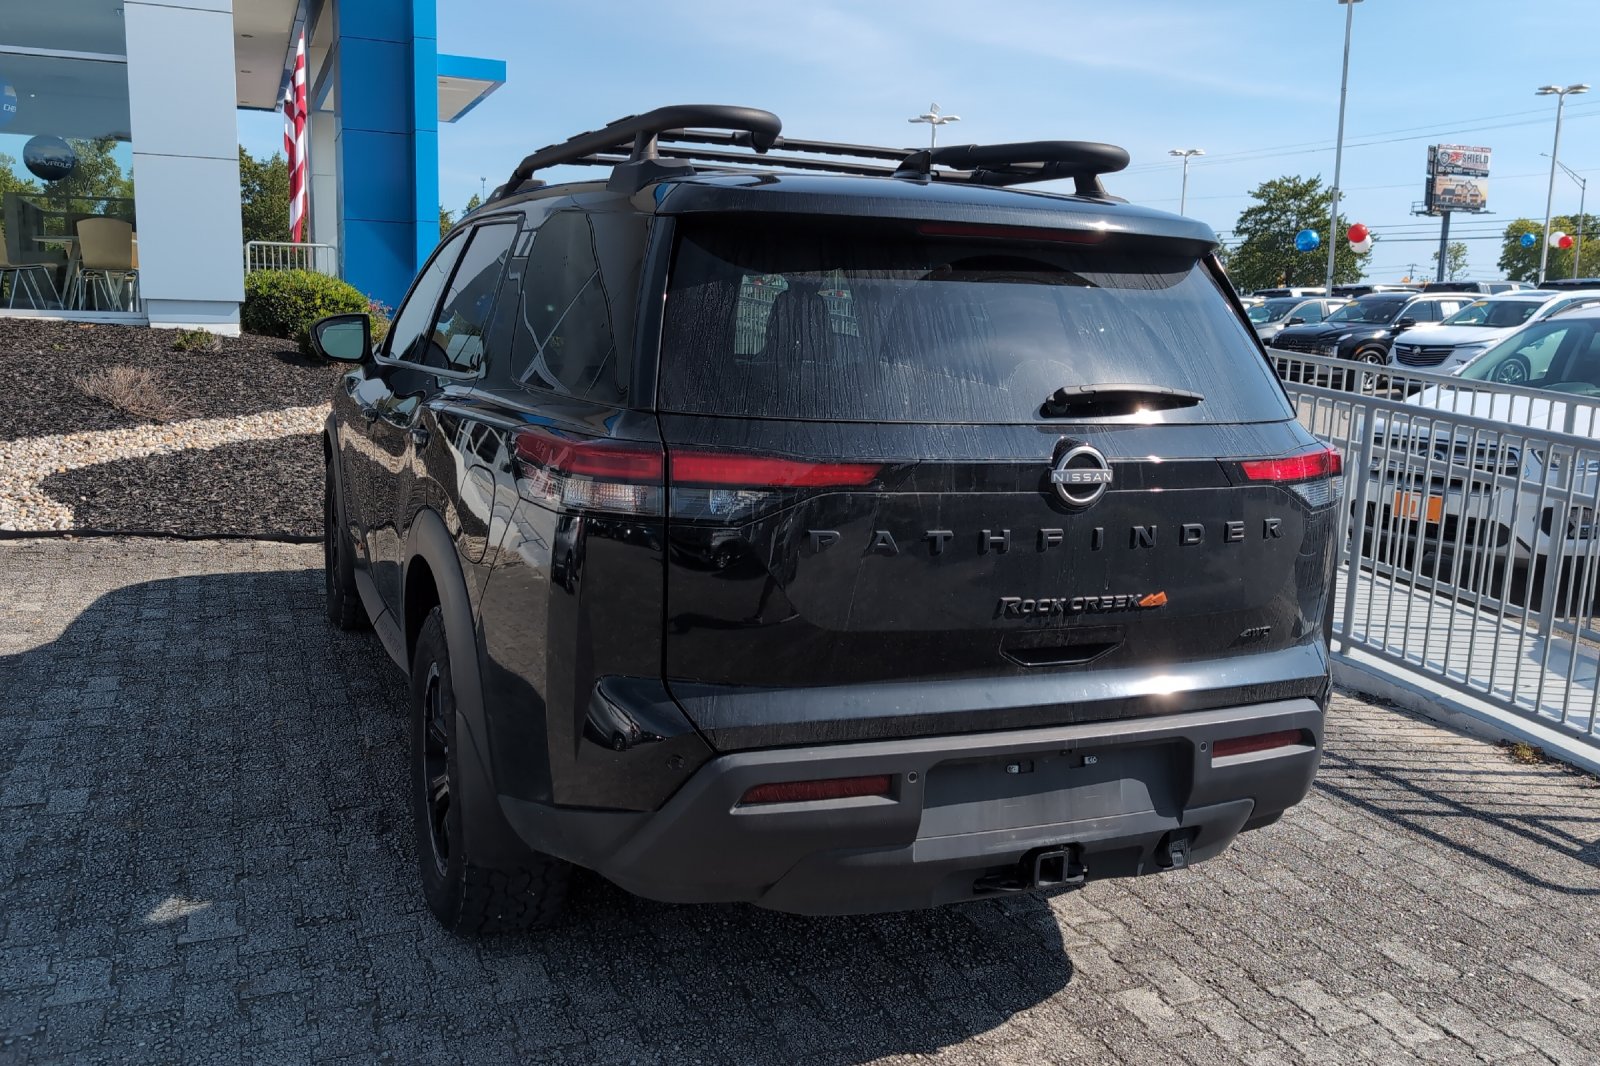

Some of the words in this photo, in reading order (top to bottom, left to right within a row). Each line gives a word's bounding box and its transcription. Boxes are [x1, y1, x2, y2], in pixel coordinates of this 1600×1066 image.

[1462, 153, 1489, 164] SHIELD
[1053, 472, 1112, 482] NISSAN
[807, 518, 1283, 554] PATHFINDER
